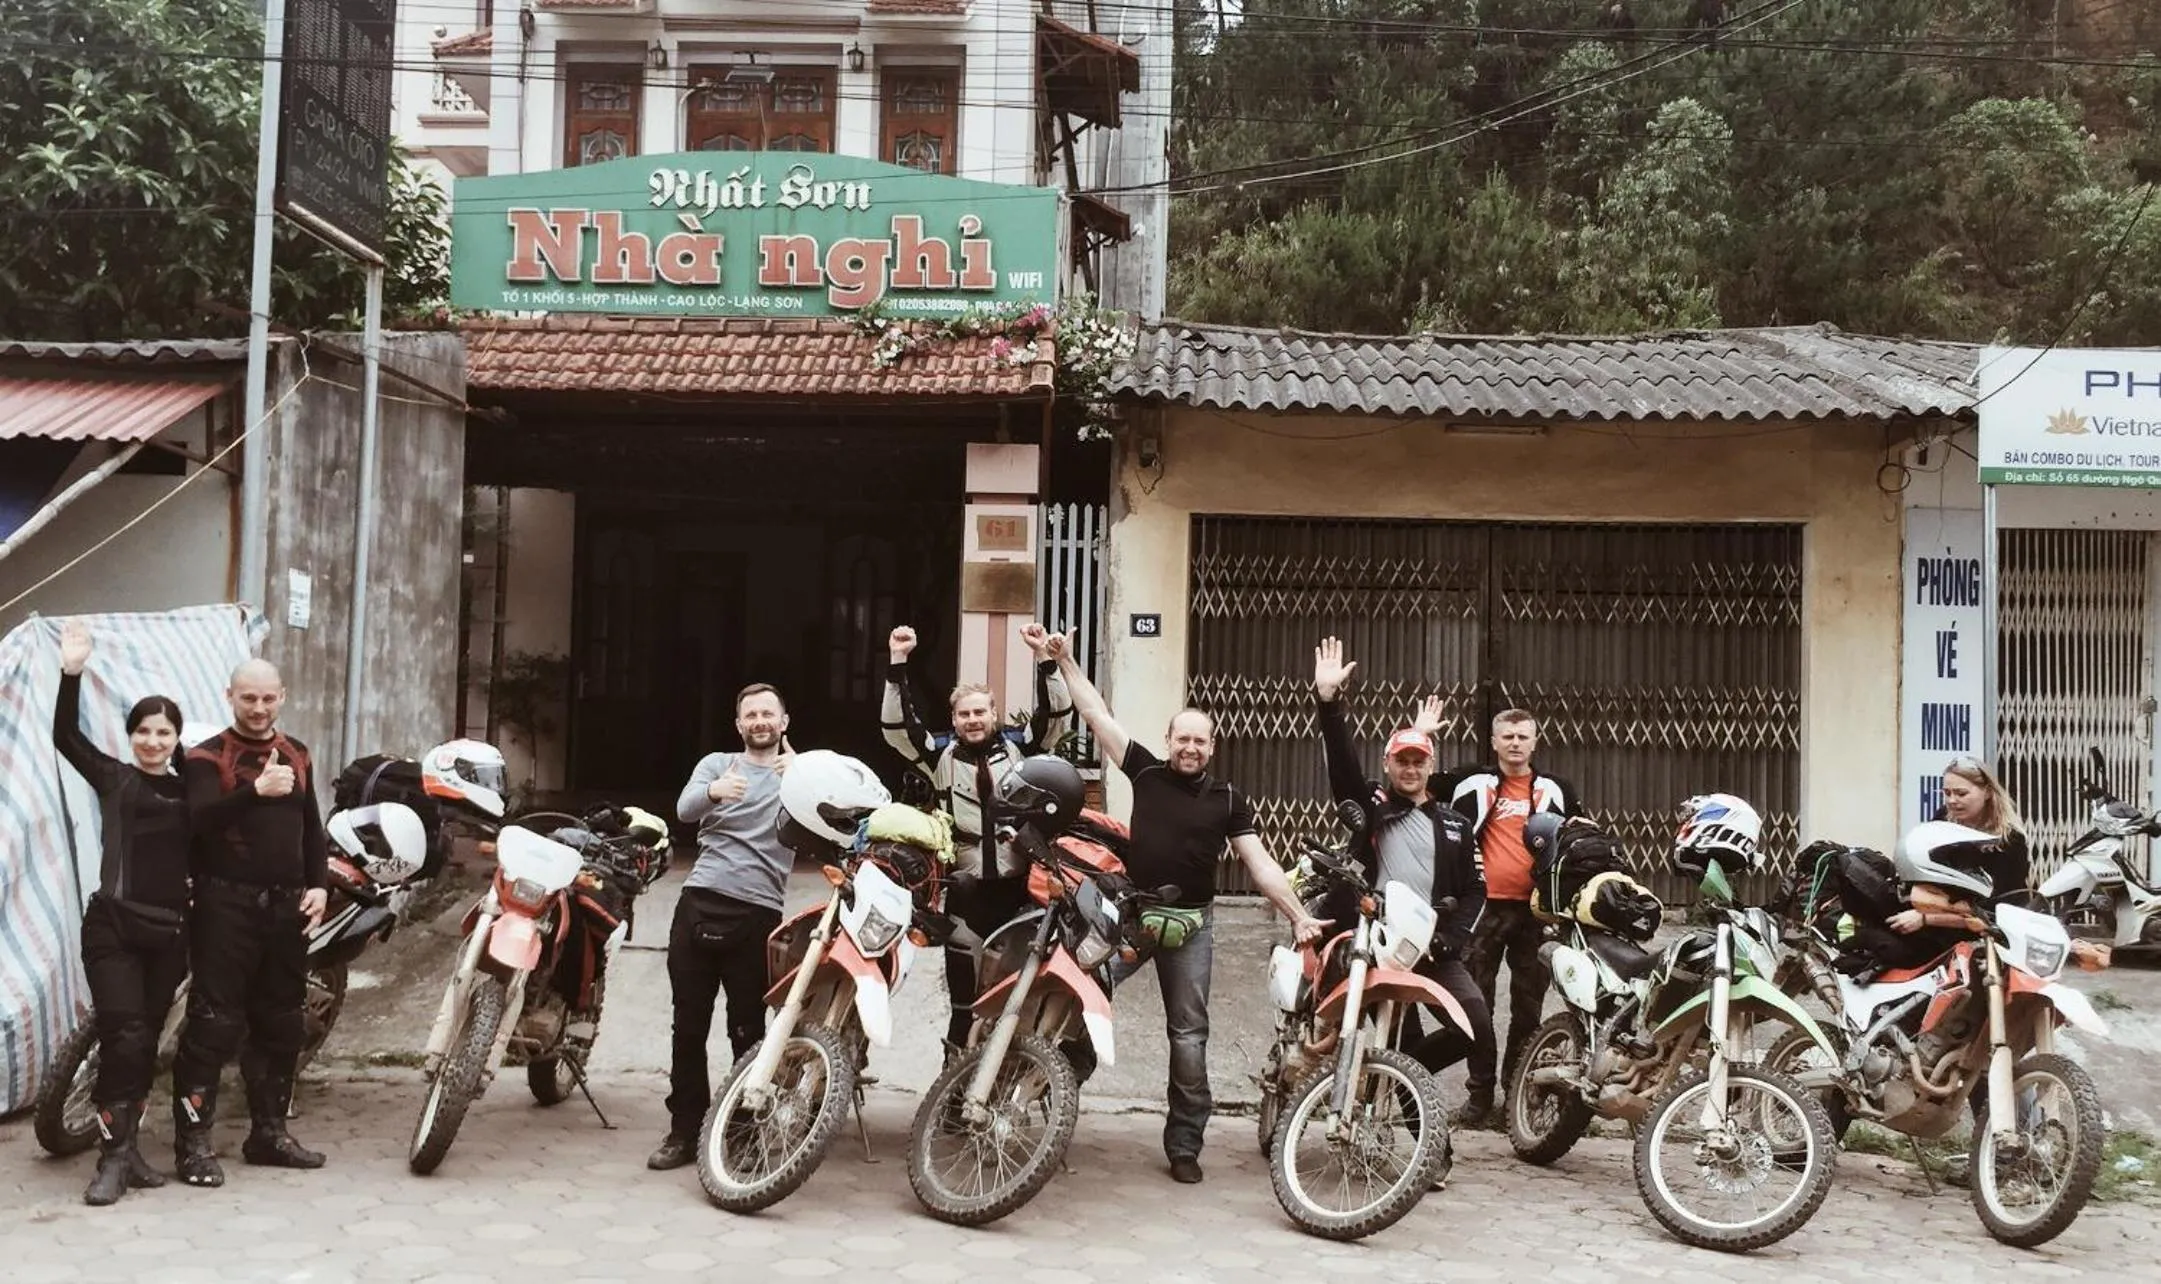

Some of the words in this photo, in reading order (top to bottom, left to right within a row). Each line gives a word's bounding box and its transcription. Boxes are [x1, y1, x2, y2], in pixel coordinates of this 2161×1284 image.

[649, 165, 768, 219] Nhất
[776, 163, 873, 211] Sơn
[507, 208, 724, 285] Nhà
[1008, 271, 1043, 290] WIFI
[2031, 452, 2074, 465] COMBO
[2077, 454, 2093, 465] DU
[2129, 455, 2160, 467] TOUR
[2066, 473, 2079, 483] 65
[1917, 546, 1980, 607] PHÒNG
[1136, 618, 1156, 633] 63
[1936, 620, 1957, 678] VÉ
[1921, 702, 1970, 752] MINH
